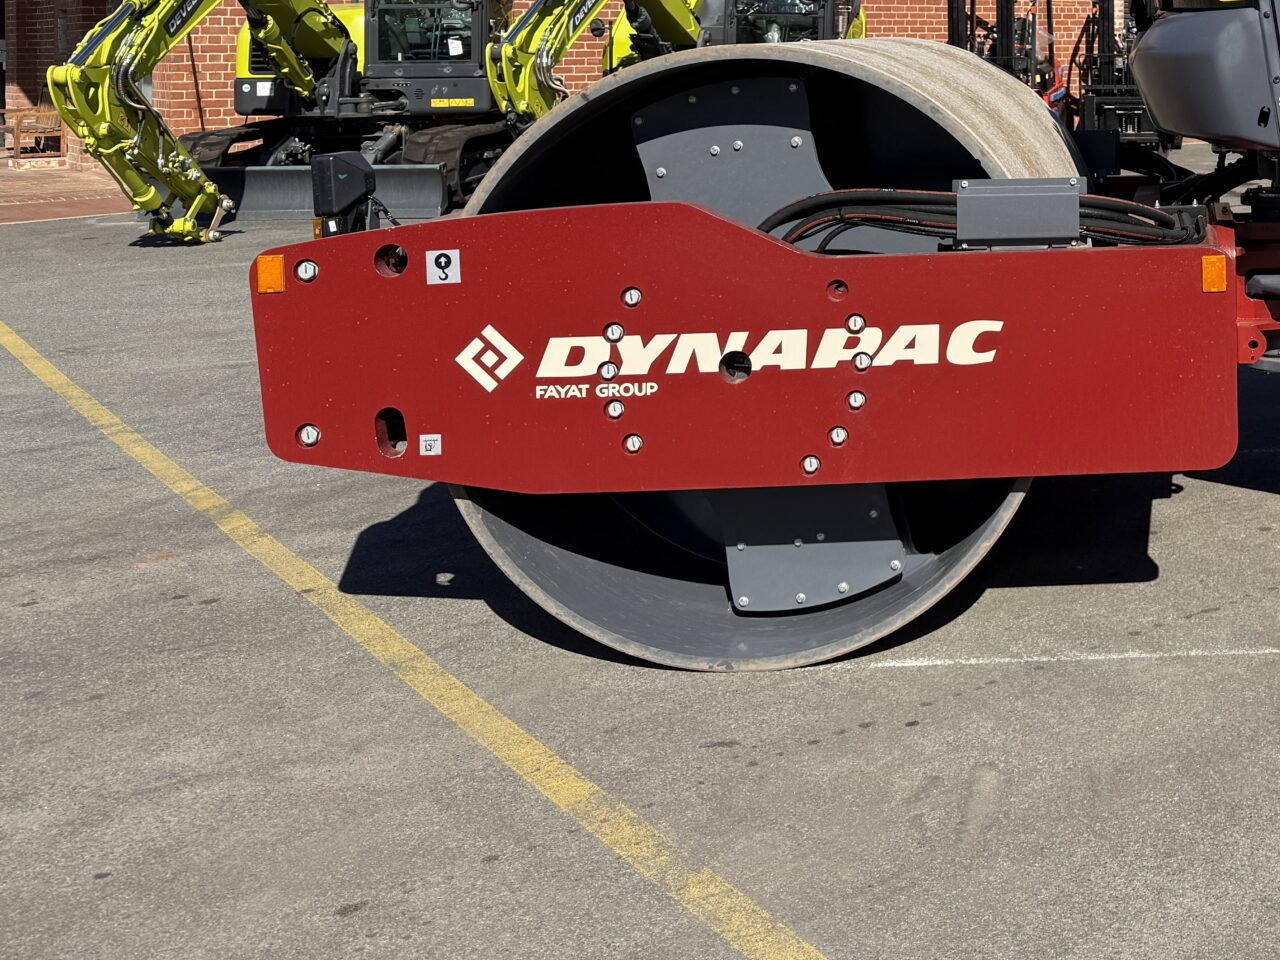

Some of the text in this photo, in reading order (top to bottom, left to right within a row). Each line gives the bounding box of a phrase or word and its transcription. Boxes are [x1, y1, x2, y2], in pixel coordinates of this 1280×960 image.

[535, 320, 1004, 378] DYNAPAC
[535, 382, 658, 399] FAYAT GROUP
